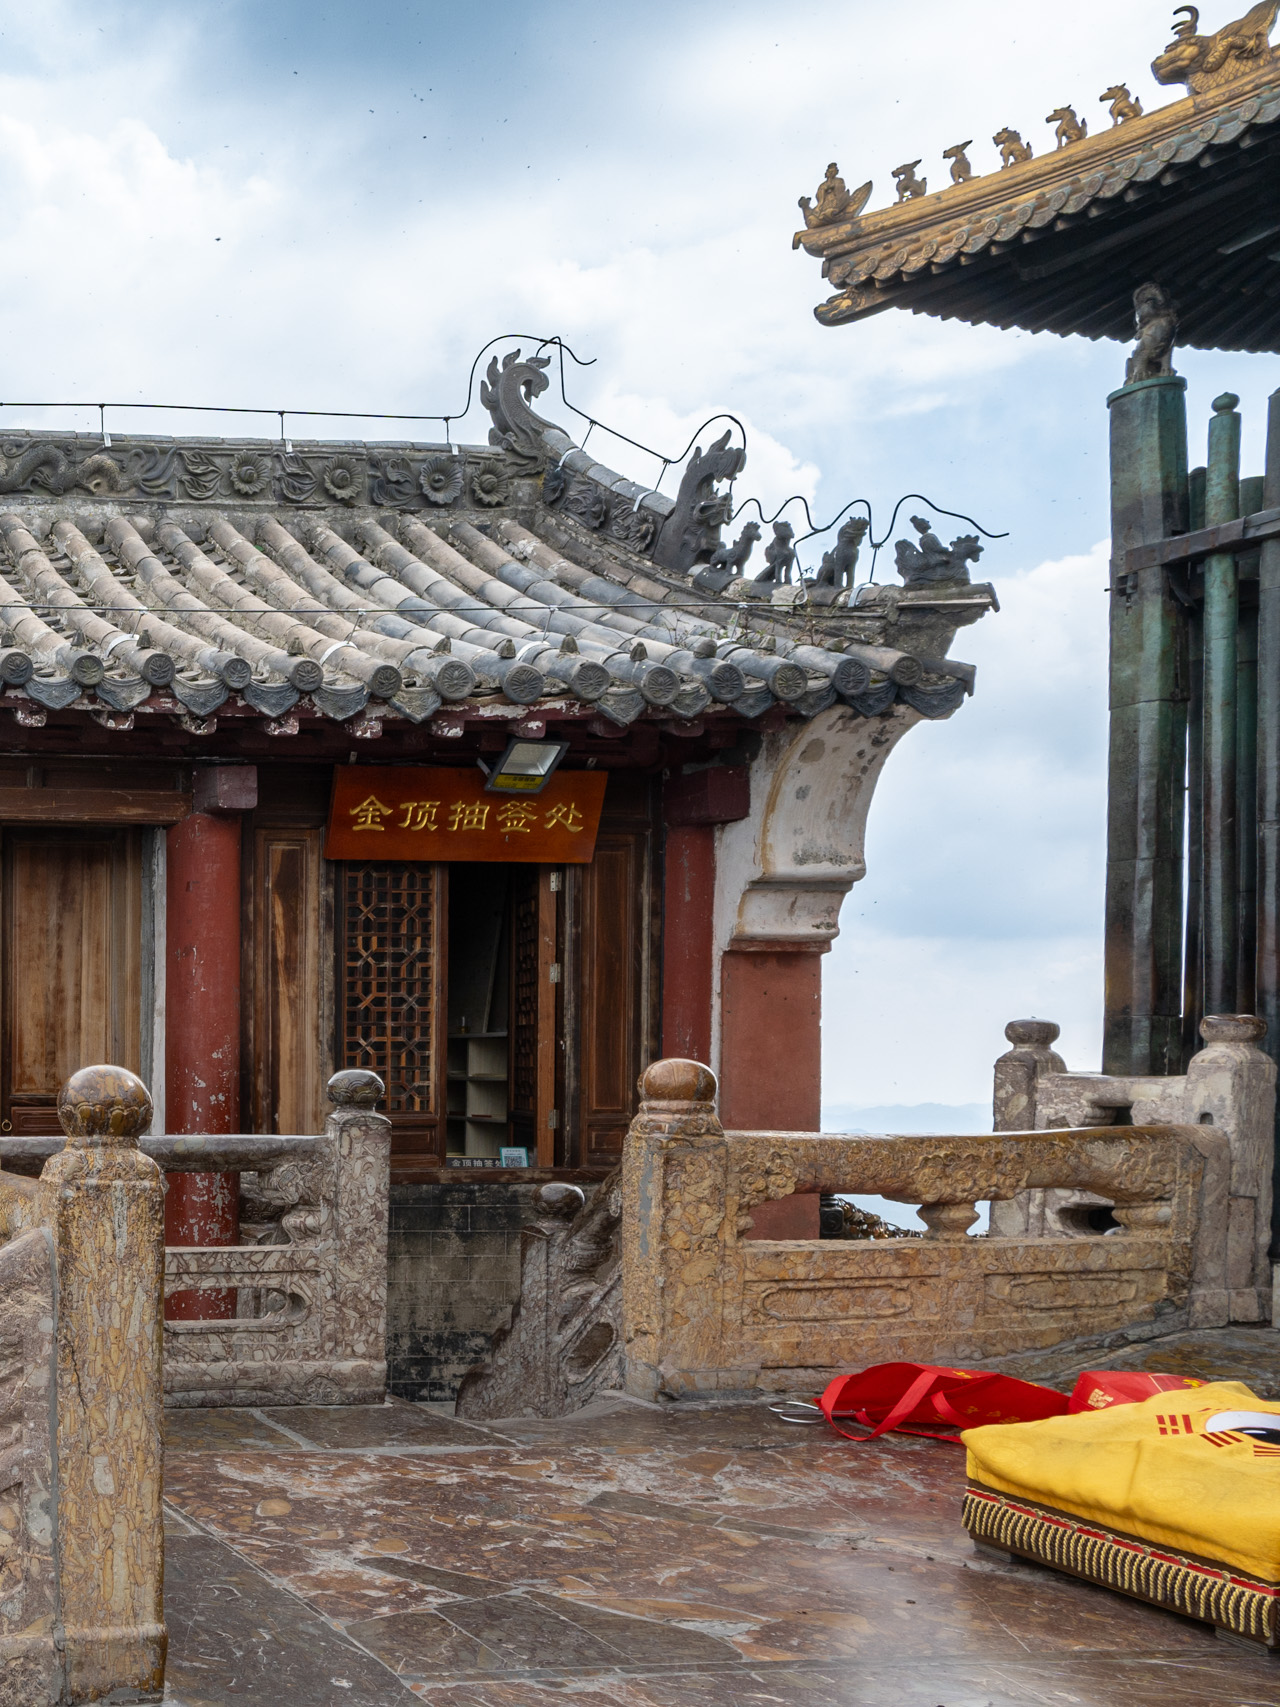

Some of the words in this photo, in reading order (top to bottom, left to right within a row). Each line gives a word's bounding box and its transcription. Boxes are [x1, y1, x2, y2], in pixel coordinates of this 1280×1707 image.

[349, 794, 584, 833] 金顶抽签处
